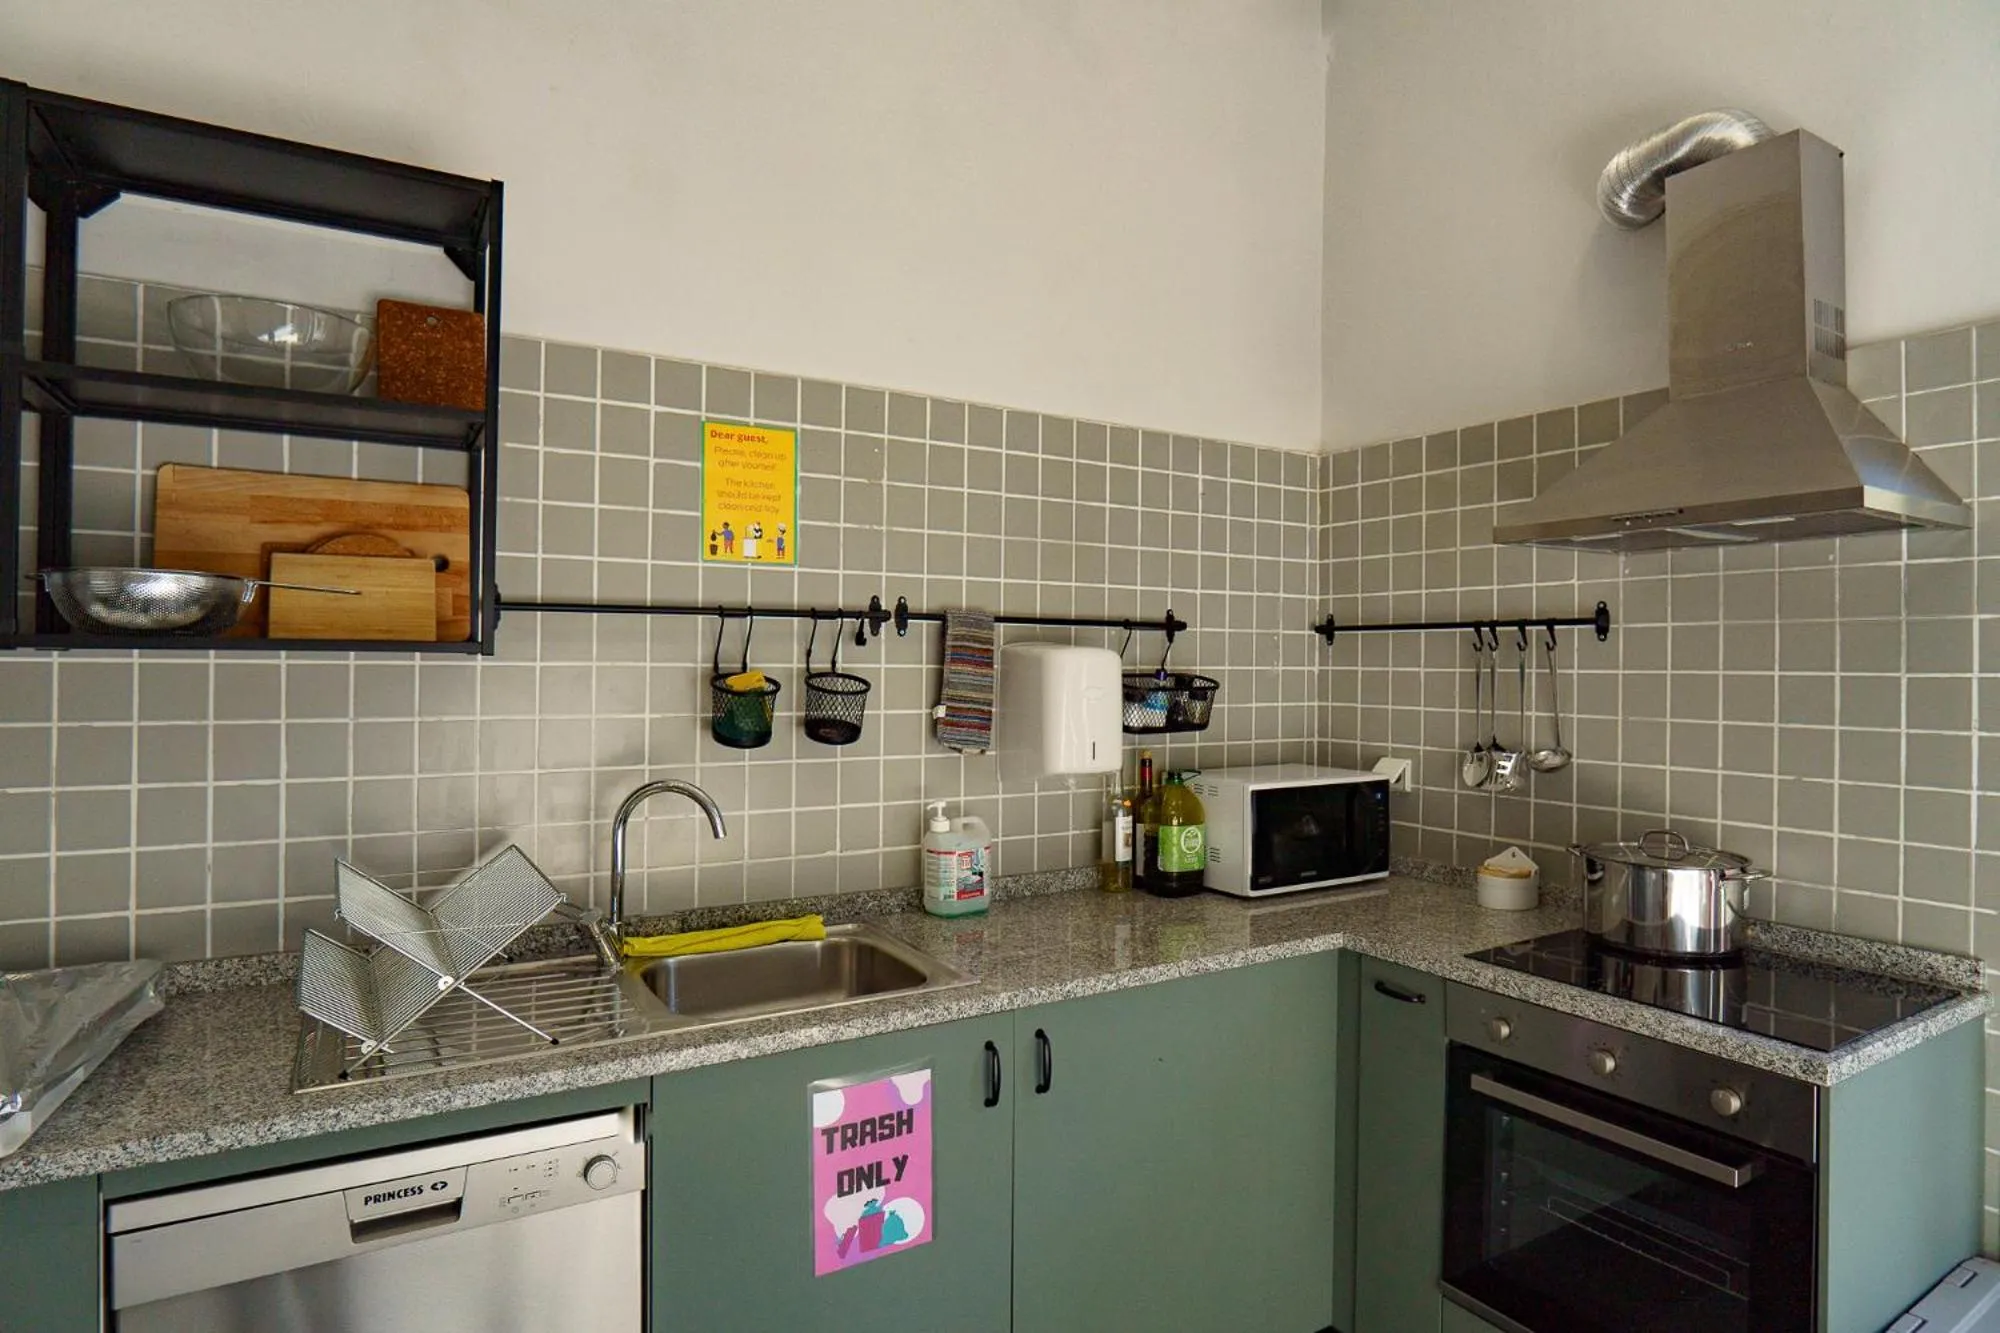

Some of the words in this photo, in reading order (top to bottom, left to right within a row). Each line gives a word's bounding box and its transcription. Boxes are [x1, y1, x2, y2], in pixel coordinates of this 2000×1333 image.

[710, 430, 735, 440] Dear
[821, 1107, 914, 1155] TRASH
[836, 1154, 909, 1198] ONLY
[363, 1184, 424, 1206] PRINCESS
